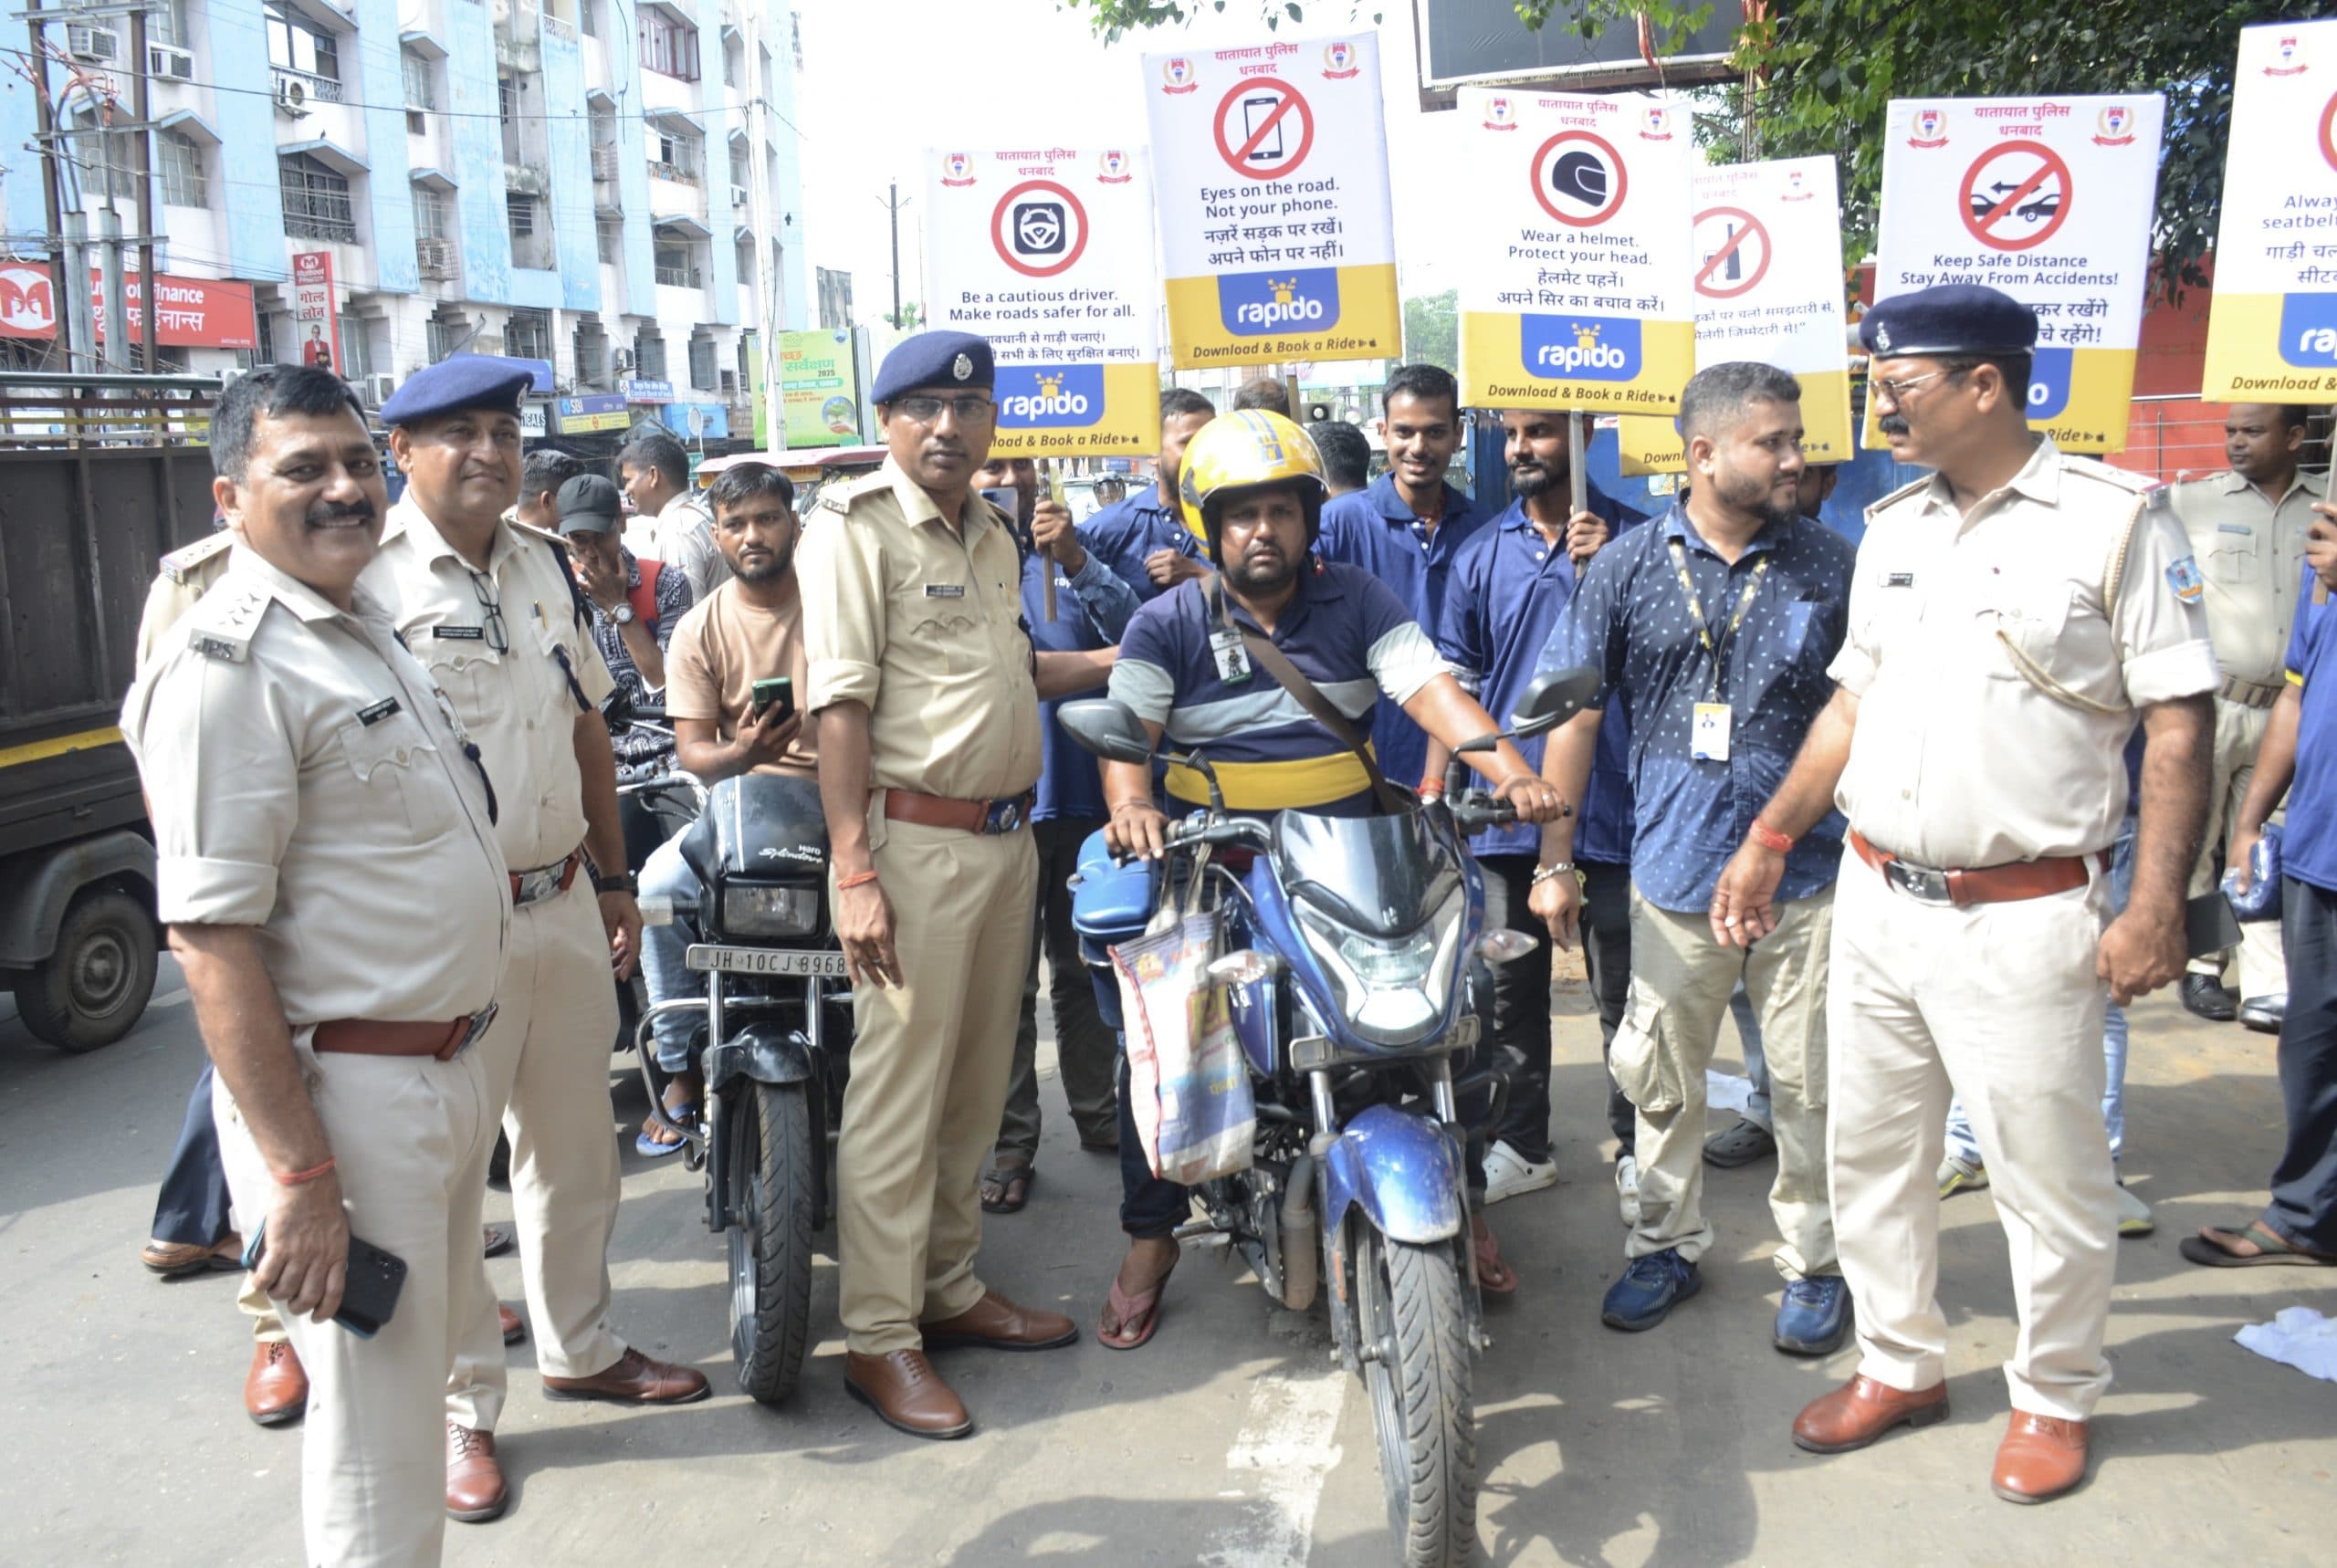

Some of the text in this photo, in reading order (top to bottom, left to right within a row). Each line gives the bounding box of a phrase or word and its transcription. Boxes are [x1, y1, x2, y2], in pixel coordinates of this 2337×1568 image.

[1214, 42, 1298, 61] यातायात पुलिस
[1238, 63, 1277, 76] धनबाद
[1538, 99, 1619, 114] यातायात पुलिस
[1975, 103, 2070, 120] यातायात पुलिस
[1999, 124, 2042, 137] धनबाद
[995, 148, 1076, 163] यातायात पुलिस
[1018, 167, 1055, 177] धनबाद
[1200, 177, 1340, 204] Eyes on the road.
[1205, 198, 1338, 219] Not your phone.
[1242, 225, 1283, 243] सड़क
[1287, 223, 1306, 237] पर
[1521, 228, 1640, 247] Wear a helmet.
[1208, 246, 1244, 266] अपने
[1248, 245, 1281, 264] फोन
[1284, 246, 1305, 261] पर
[1509, 246, 1652, 265] Protect your head.
[2266, 241, 2305, 261] गाड़ी
[1934, 255, 2088, 269] Keep Safe Distance
[1537, 267, 1581, 286] हेलमेट
[1901, 272, 2118, 287] Stay Away From Accidents!
[150, 286, 204, 304] inance
[961, 288, 1118, 304] Be a cautious driver.
[1497, 288, 1533, 305] अपने
[1538, 288, 1564, 306] सिर
[1569, 295, 1588, 308] का
[1593, 296, 1631, 309] बचाव
[949, 304, 1136, 320] Make roads safer for all.
[1238, 296, 1323, 328] rapido
[1720, 311, 1734, 320] पर
[2068, 298, 2109, 318] रखेंगे
[1030, 331, 1040, 343] से
[2038, 324, 2054, 342] चे
[1001, 348, 1023, 361] सभी
[1028, 348, 1038, 360] के
[1042, 347, 1063, 361] लिए
[1066, 346, 1104, 361] सुरक्षित
[1193, 337, 1356, 358] Download & Book a Ride
[1538, 341, 1625, 371] rapido
[2231, 376, 2320, 390] Download
[1488, 383, 1656, 402] Download & Book a Ride
[570, 398, 584, 413] SBI
[1003, 395, 1087, 421] rapido
[521, 413, 546, 426] ICALS
[1026, 435, 1035, 446] &
[1040, 434, 1073, 446] Book
[1077, 435, 1085, 445] a
[1090, 432, 1119, 444] Ride
[798, 845, 822, 855] Hero
[711, 952, 845, 973] JH 10CJ 8968
